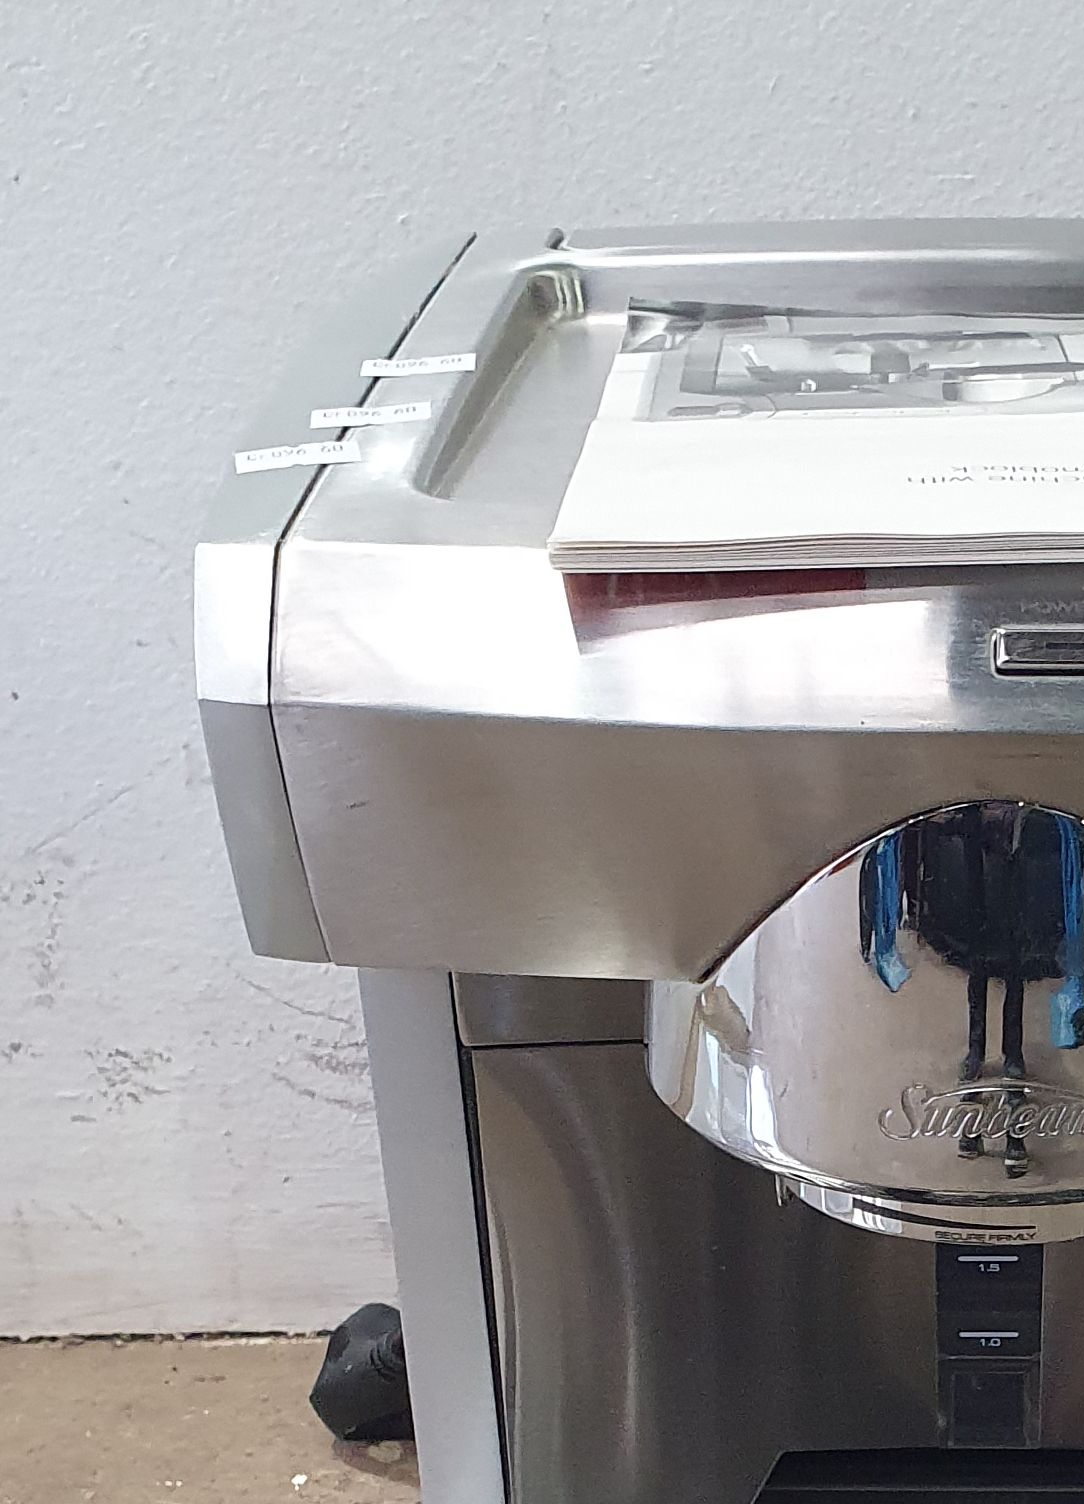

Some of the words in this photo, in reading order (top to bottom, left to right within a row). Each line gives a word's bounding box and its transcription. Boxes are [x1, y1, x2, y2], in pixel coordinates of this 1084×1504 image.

[906, 475, 974, 484] with
[978, 1263, 1001, 1273] 1.5
[979, 1338, 1002, 1347] 1.0
